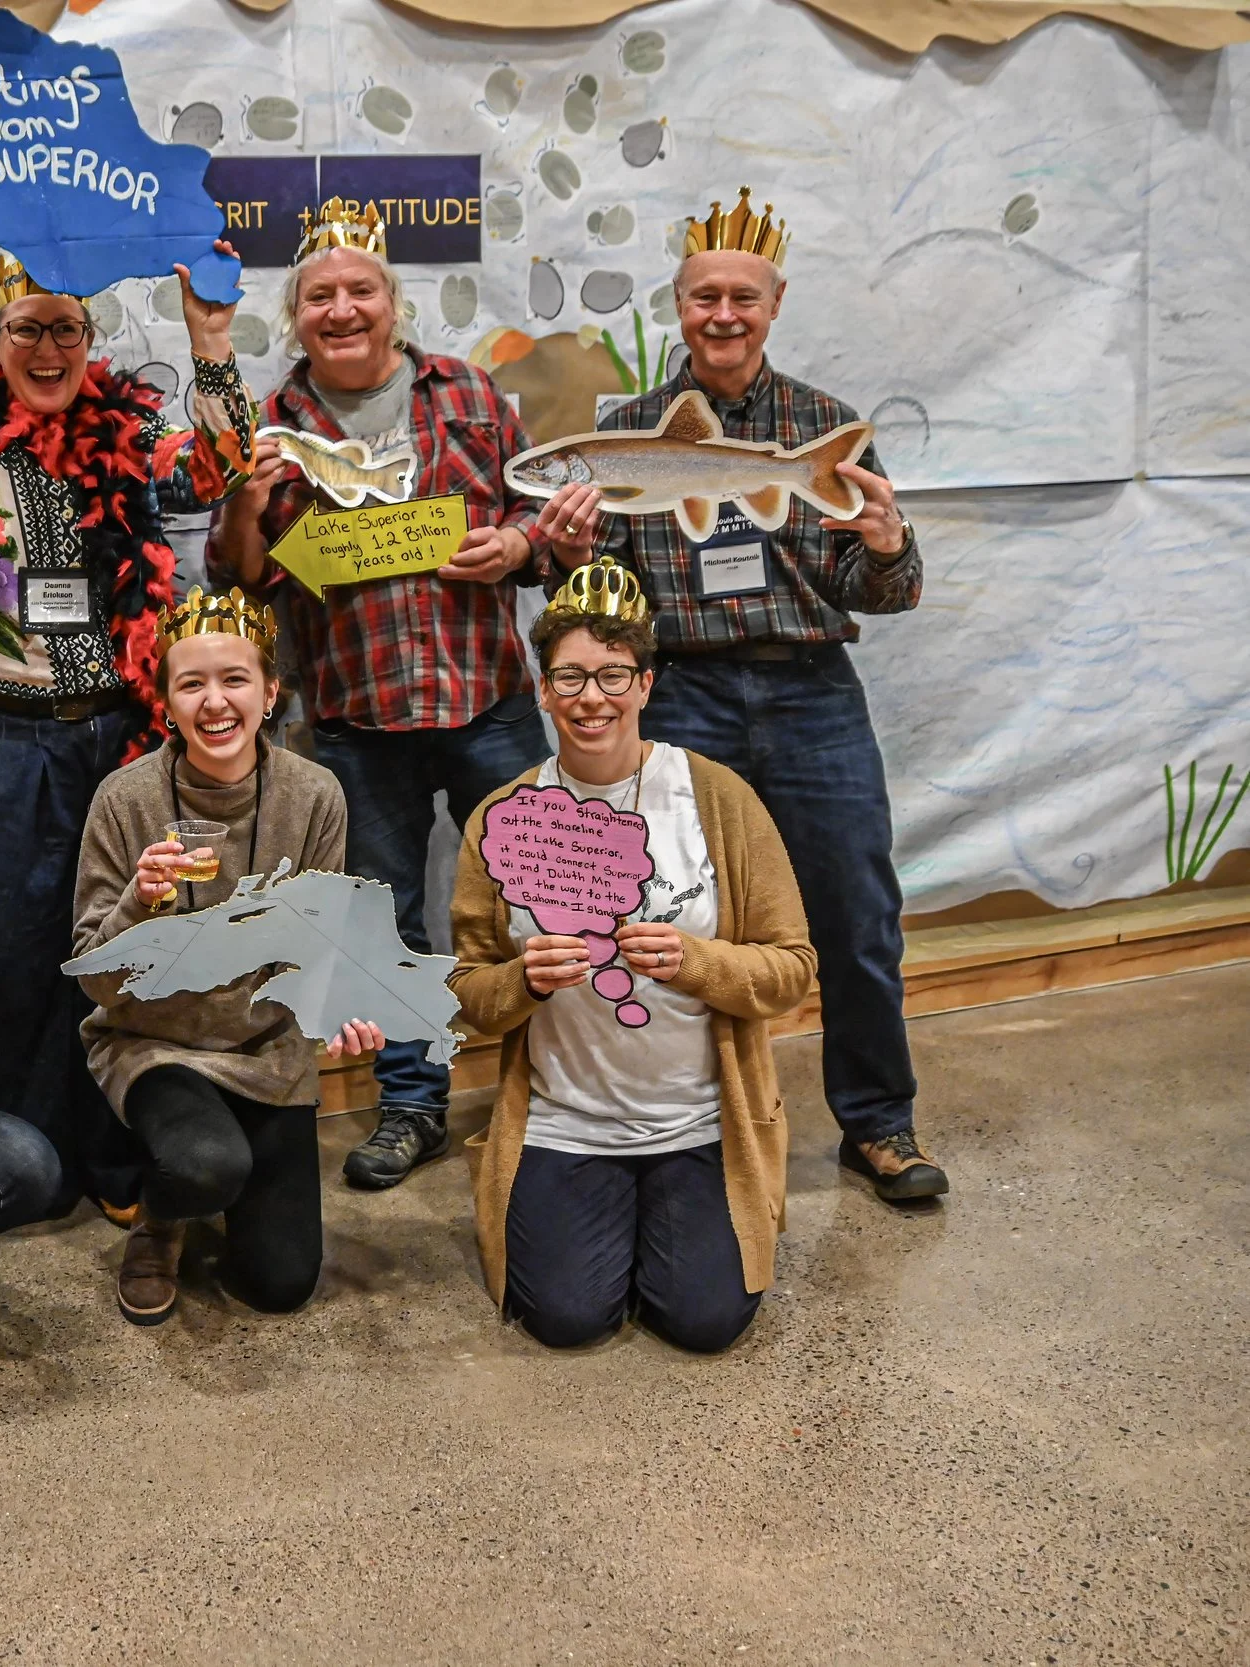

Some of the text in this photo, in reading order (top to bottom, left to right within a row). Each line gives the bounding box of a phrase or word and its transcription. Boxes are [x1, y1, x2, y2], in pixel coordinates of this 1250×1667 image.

[214, 201, 269, 229] RIT
[304, 505, 446, 539] Lake Superior is
[320, 541, 363, 558] roughly
[403, 525, 451, 542] Billion
[353, 553, 395, 574] years
[517, 795, 644, 831] If you Straightened
[551, 820, 604, 837] shoreline
[515, 833, 623, 859] of Lake Superior,
[500, 844, 642, 880] it could connect Superior
[520, 864, 539, 873] and
[547, 868, 585, 882] Duluth
[508, 876, 626, 904] all the way to the
[522, 891, 568, 907] Bahama
